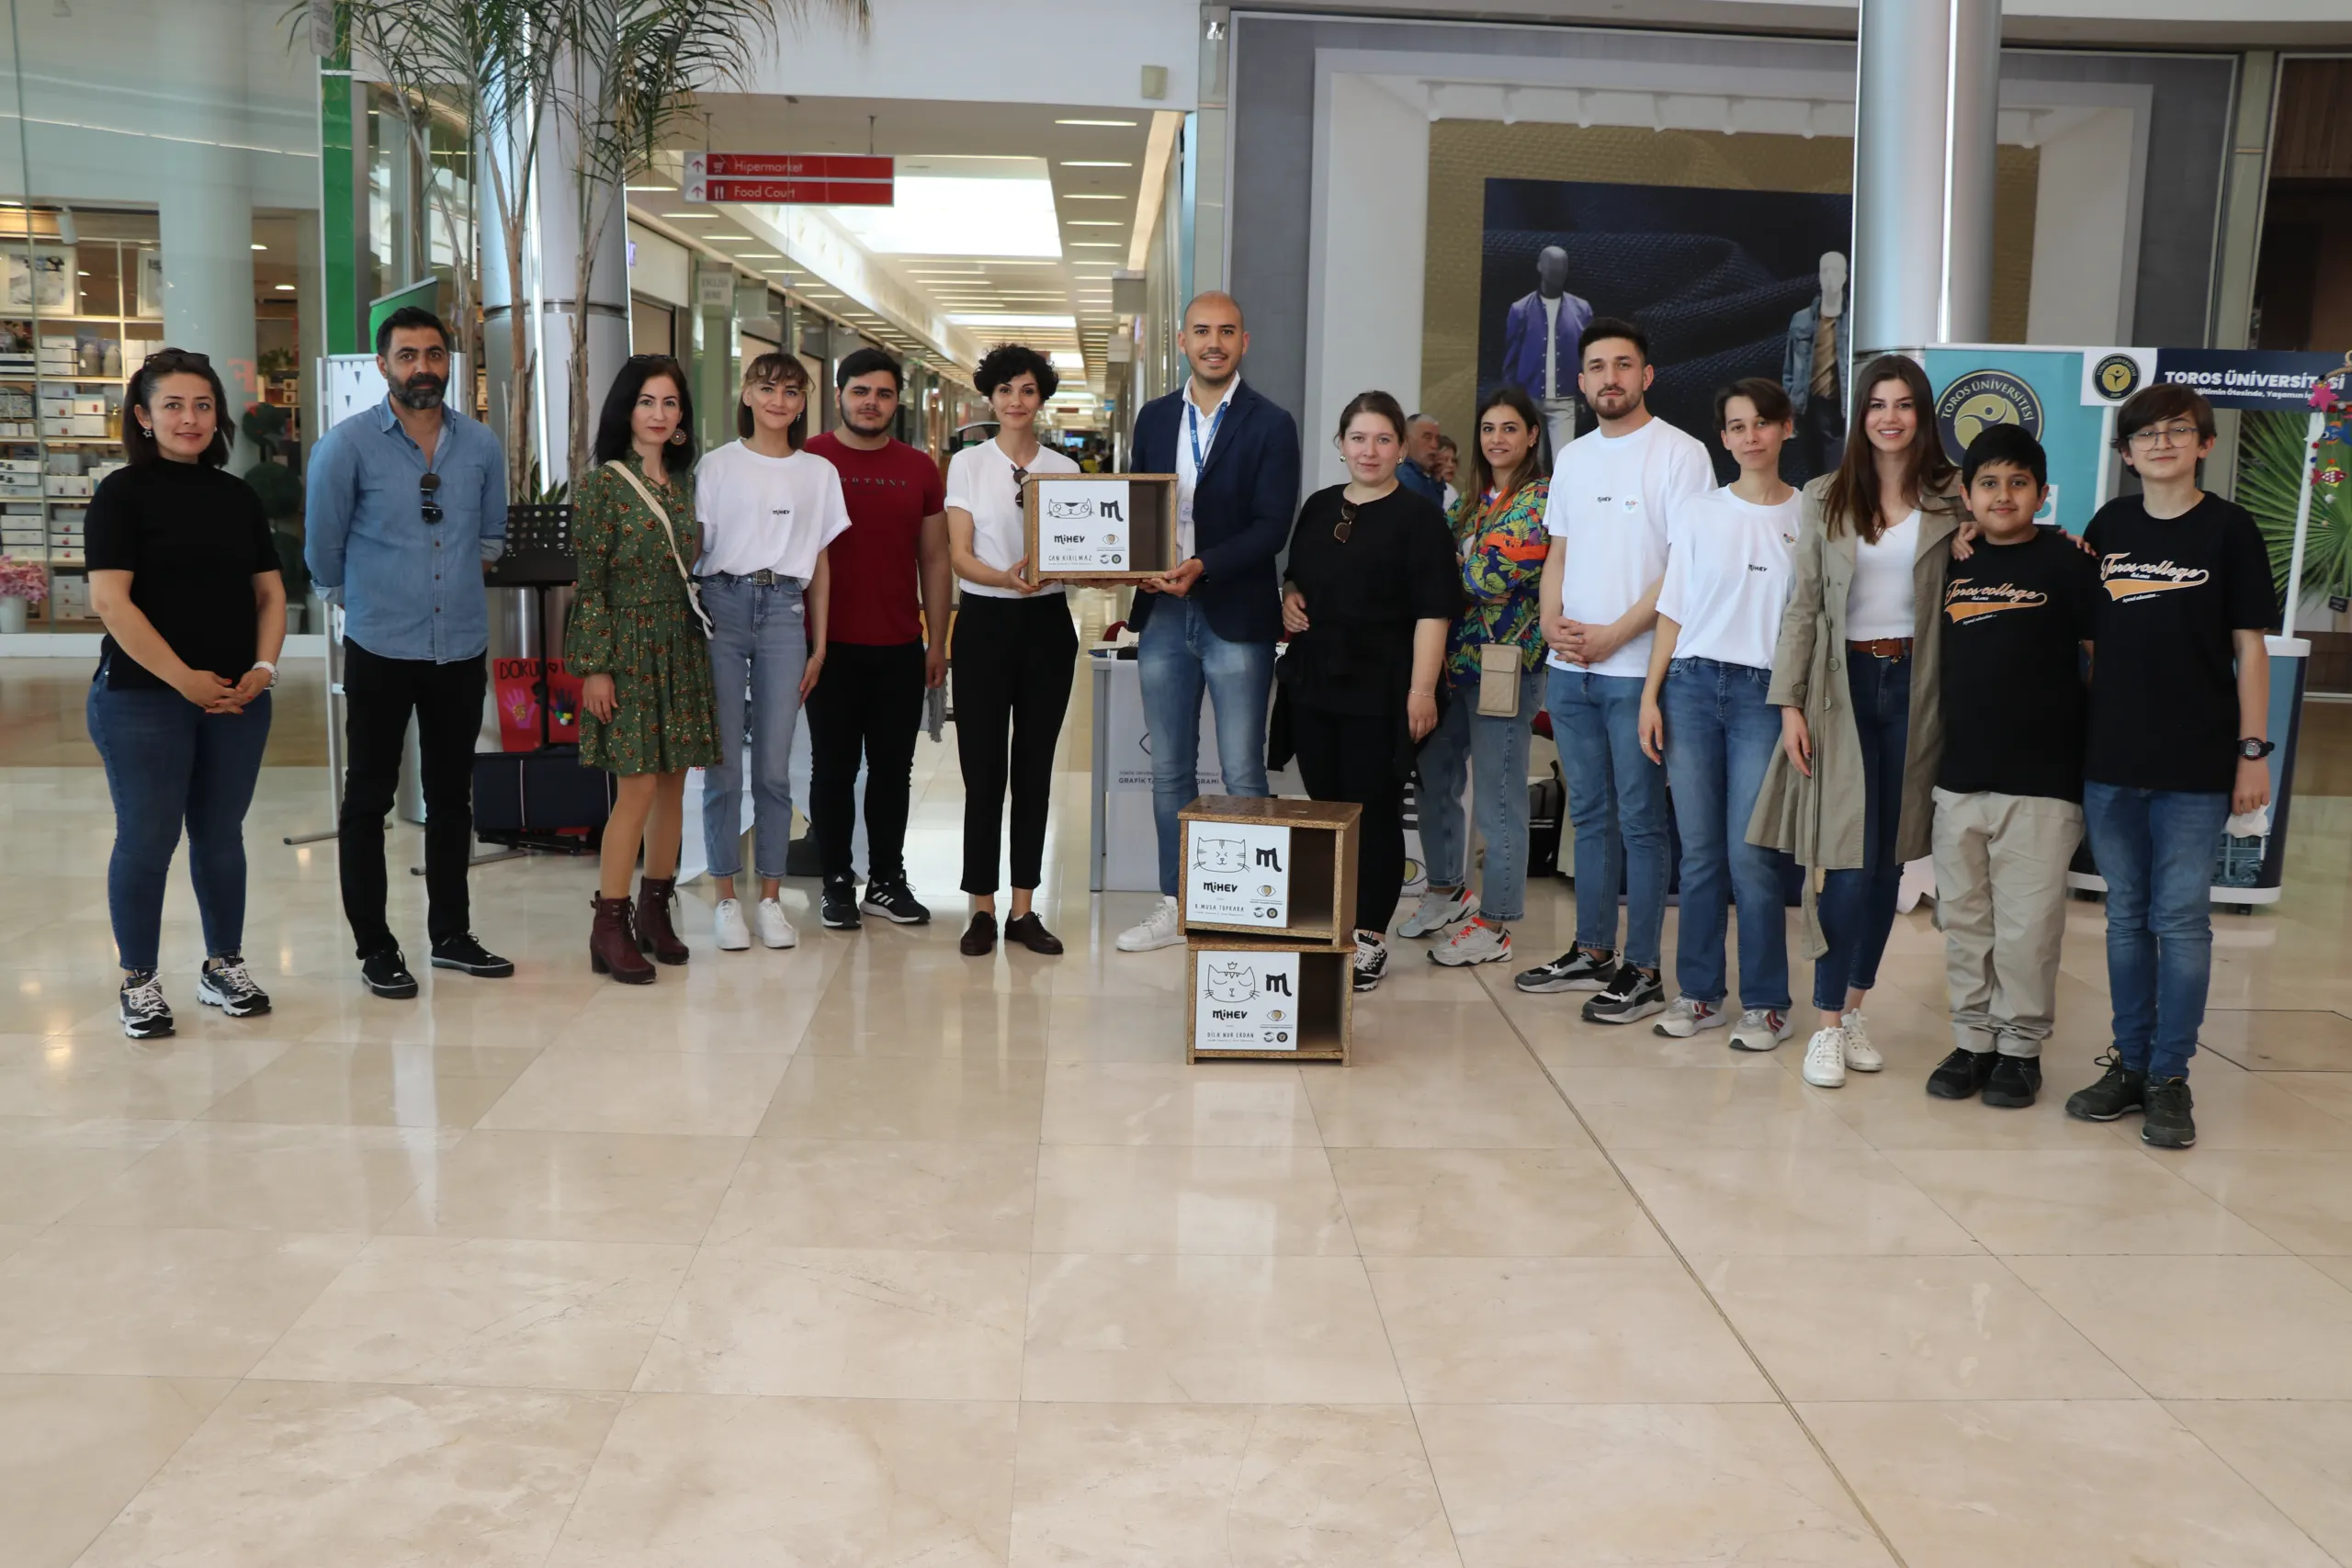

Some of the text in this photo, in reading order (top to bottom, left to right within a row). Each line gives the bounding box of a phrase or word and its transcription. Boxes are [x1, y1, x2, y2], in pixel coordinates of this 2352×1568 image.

[734, 160, 804, 174] Hipermarket
[734, 186, 796, 199] Food Court
[2164, 369, 2346, 390] TOROS ÜNİVERSİTSİ
[1940, 378, 2036, 422] TOROS ÜNİVERSİTESİ
